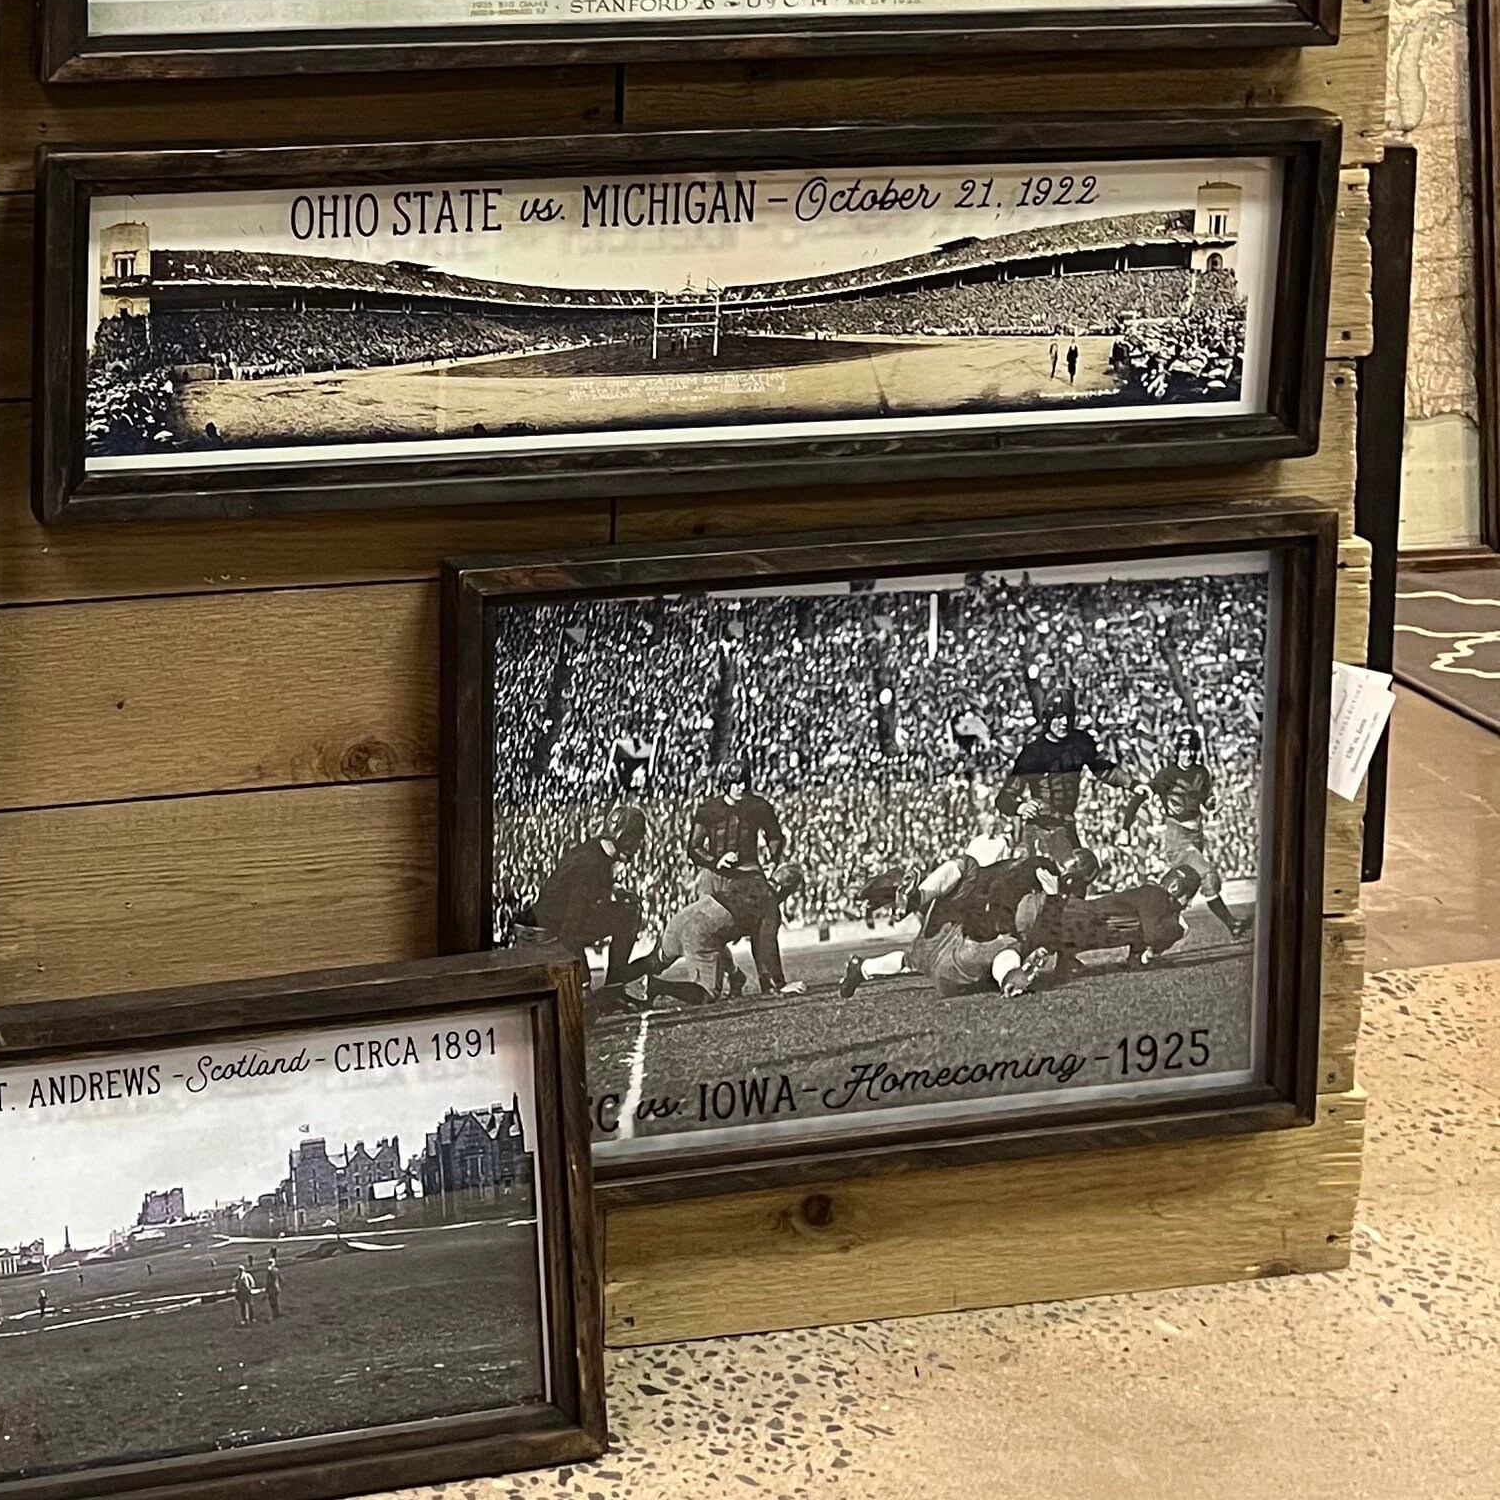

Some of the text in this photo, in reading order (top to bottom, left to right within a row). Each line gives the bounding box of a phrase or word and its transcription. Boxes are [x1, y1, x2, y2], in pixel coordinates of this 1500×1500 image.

[290, 193, 380, 240] OHIO
[392, 188, 503, 236] STATE
[518, 198, 567, 223] vs.
[581, 179, 758, 229] MICHIGAN
[795, 176, 942, 222] October
[1015, 175, 1101, 208] 1922
[28, 1064, 163, 1109] ANDREWS
[186, 1047, 313, 1093] Scotland
[333, 1036, 421, 1073] CIRCA
[430, 1026, 498, 1061] 1891
[698, 1074, 798, 1122] IOWA
[822, 1051, 1087, 1108] Homecoming
[1117, 1029, 1211, 1075] 1925
